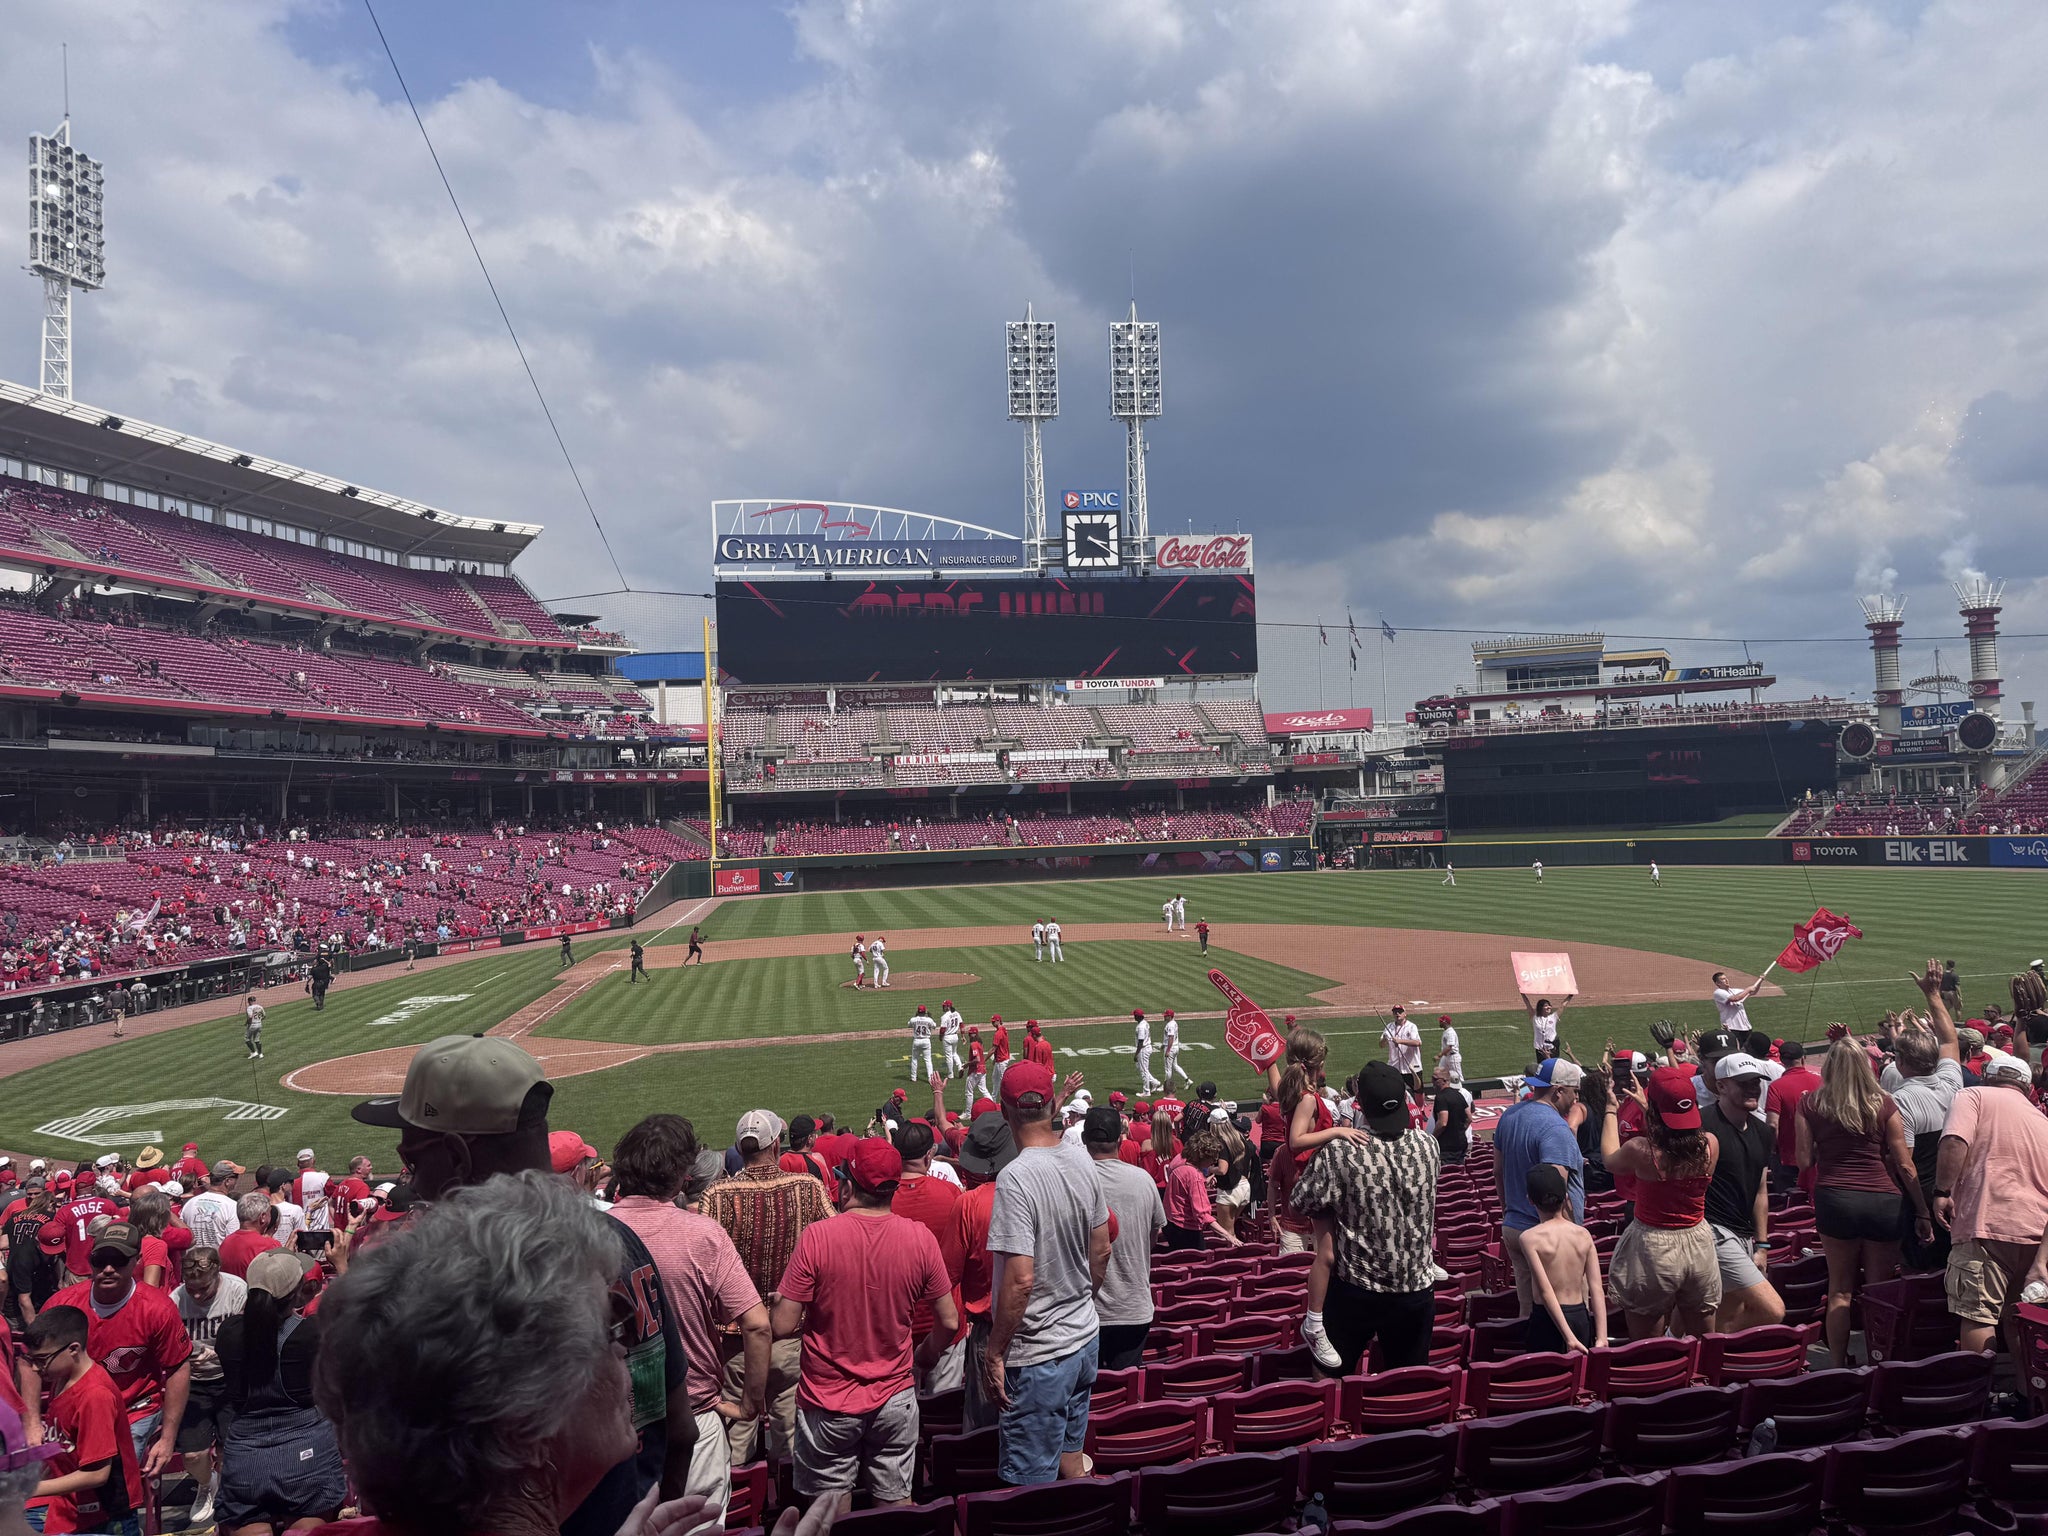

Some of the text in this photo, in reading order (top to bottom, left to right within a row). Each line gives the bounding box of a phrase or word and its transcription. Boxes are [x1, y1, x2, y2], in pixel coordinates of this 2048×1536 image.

[1082, 492, 1119, 506] PNC
[721, 538, 809, 560] GREAT
[939, 556, 987, 564] INSURANCE
[989, 555, 1018, 564] GROUP
[1157, 536, 1250, 569] Coca-Cola
[1710, 666, 1760, 678] TriHealth
[1086, 679, 1156, 689] TOYOTA TUNDRA
[1908, 674, 1961, 686] CINCINNATI
[749, 693, 793, 702] TARPS
[857, 690, 929, 699] TARPS OFF
[1419, 710, 1454, 720] TUNDRA
[1927, 705, 1960, 718] PNC
[1282, 713, 1347, 726] Reds
[1903, 716, 1961, 727] POWER STAC
[1814, 847, 1858, 856] TOYOTA
[718, 884, 759, 893] Budweiser
[916, 1025, 927, 1035] 43
[1256, 1034, 1278, 1055] REDS
[1717, 1034, 1729, 1047] T
[71, 1202, 105, 1217] ROSE
[76, 1218, 86, 1241] 1
